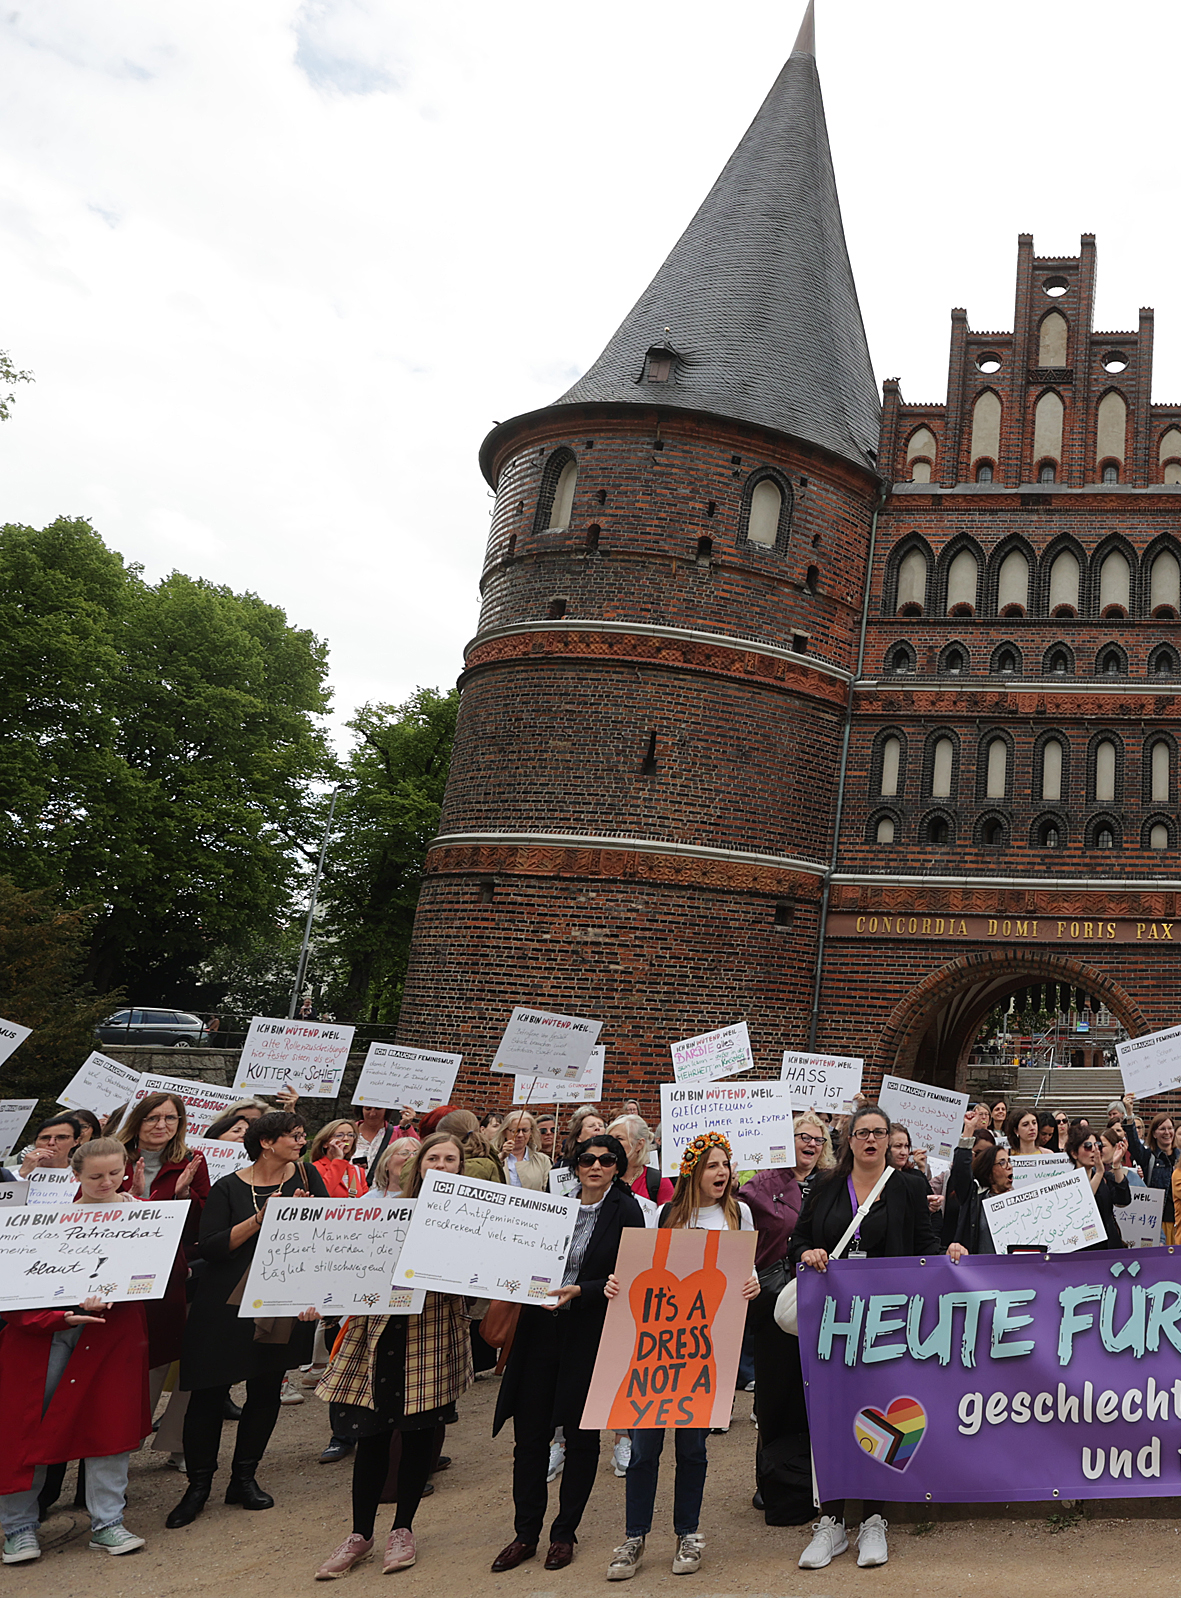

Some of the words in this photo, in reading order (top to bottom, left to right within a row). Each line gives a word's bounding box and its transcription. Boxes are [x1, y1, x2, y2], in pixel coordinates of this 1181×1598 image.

[856, 916, 969, 936] CONCORDIA
[987, 919, 1039, 938] DOMI
[1057, 921, 1117, 939] FORIS
[1136, 922, 1174, 940] PAX
[257, 1024, 269, 1033] ICH
[271, 1025, 285, 1035] BIN
[322, 1031, 340, 1040] WEIL
[517, 1013, 529, 1022] ICH
[529, 1015, 542, 1024] BIN
[573, 1023, 589, 1033] WEIL
[676, 1044, 685, 1052] ICH
[686, 1041, 695, 1049] BIN
[723, 1029, 737, 1038] WEIL
[374, 1048, 387, 1056] ICH
[388, 1049, 417, 1060] BRAUCHE
[418, 1055, 454, 1065] FEMINISMUS
[674, 1043, 715, 1064] BARBIE
[716, 1039, 734, 1049] alles
[788, 1056, 798, 1064] ICH
[246, 1063, 292, 1081] KUTTER
[293, 1068, 306, 1078] auf
[786, 1067, 826, 1083] HASS
[145, 1080, 162, 1089] ICH
[163, 1082, 200, 1096] BRAUCHE
[670, 1090, 685, 1101] ICH
[688, 1089, 703, 1101] BIN
[751, 1089, 774, 1098] WEIL
[899, 1084, 926, 1098] BRAUCHE
[927, 1092, 962, 1105] FEMINISMUS
[671, 1102, 753, 1118] GLEICHSTELLUNG
[673, 1122, 698, 1133] NOCH
[28, 1173, 46, 1182] ICH
[48, 1174, 69, 1183] BIN
[557, 1173, 571, 1183] ICH
[433, 1180, 454, 1194] ICH
[457, 1184, 506, 1205] BRAUCHE
[991, 1201, 1005, 1212] ICH
[1006, 1190, 1039, 1206] BRAUCHE
[1040, 1177, 1081, 1195] FEMINISMUS
[1133, 1193, 1151, 1202] WEIL
[6, 1214, 30, 1227] ICH
[32, 1212, 58, 1226] BIN
[128, 1209, 162, 1221] WEIL
[277, 1207, 297, 1221] ICH
[300, 1207, 323, 1221] BIN
[387, 1208, 413, 1221] WEI
[427, 1199, 451, 1212] weil
[455, 1203, 540, 1231] Antifeminismus
[0, 1233, 25, 1241] mir
[33, 1230, 59, 1240] das
[64, 1226, 164, 1240] Patriarchat
[270, 1229, 299, 1241] dass
[312, 1227, 362, 1241] Männer
[367, 1229, 388, 1244] für
[488, 1231, 507, 1242] viele
[512, 1234, 536, 1248] Fans
[540, 1237, 559, 1252] hat
[58, 1242, 105, 1255] Rechte
[262, 1243, 316, 1266] gefeiert
[377, 1245, 393, 1255] die
[24, 1260, 86, 1276] klaut
[260, 1263, 306, 1282] täglich
[314, 1260, 386, 1278] stillschweigend
[686, 1289, 707, 1321] A
[817, 1288, 1036, 1368] HEUTE
[637, 1324, 712, 1361] DRESS
[626, 1362, 687, 1398] NOT
[691, 1364, 711, 1394] A
[629, 1396, 694, 1427] YES
[1080, 1436, 1152, 1482] und
